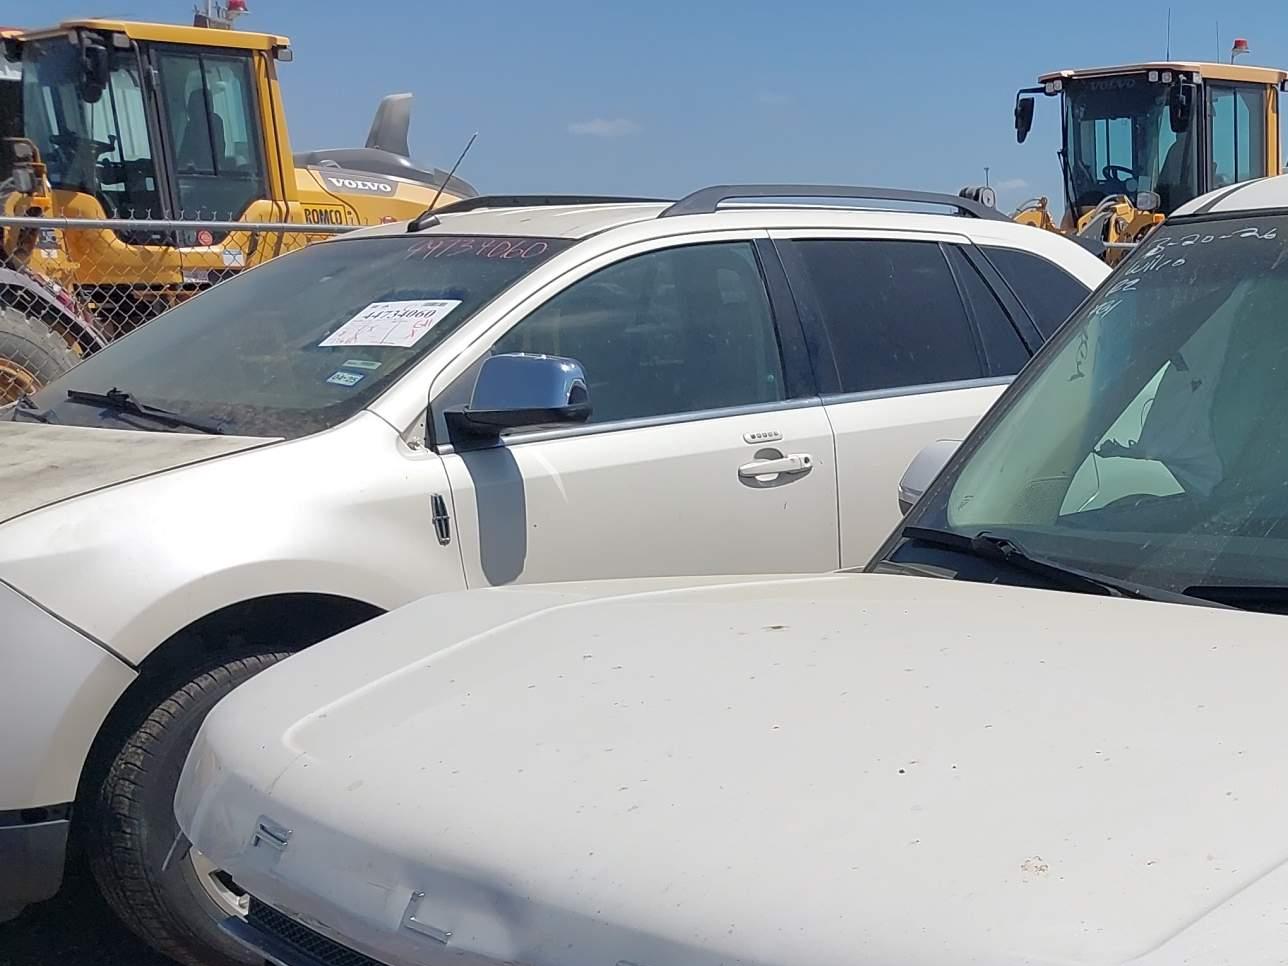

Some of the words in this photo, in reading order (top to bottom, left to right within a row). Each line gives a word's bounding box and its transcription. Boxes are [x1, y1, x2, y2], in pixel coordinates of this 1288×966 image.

[328, 177, 392, 193] VOLVO
[304, 208, 342, 225] ROMCO
[363, 308, 437, 320] 44734060
